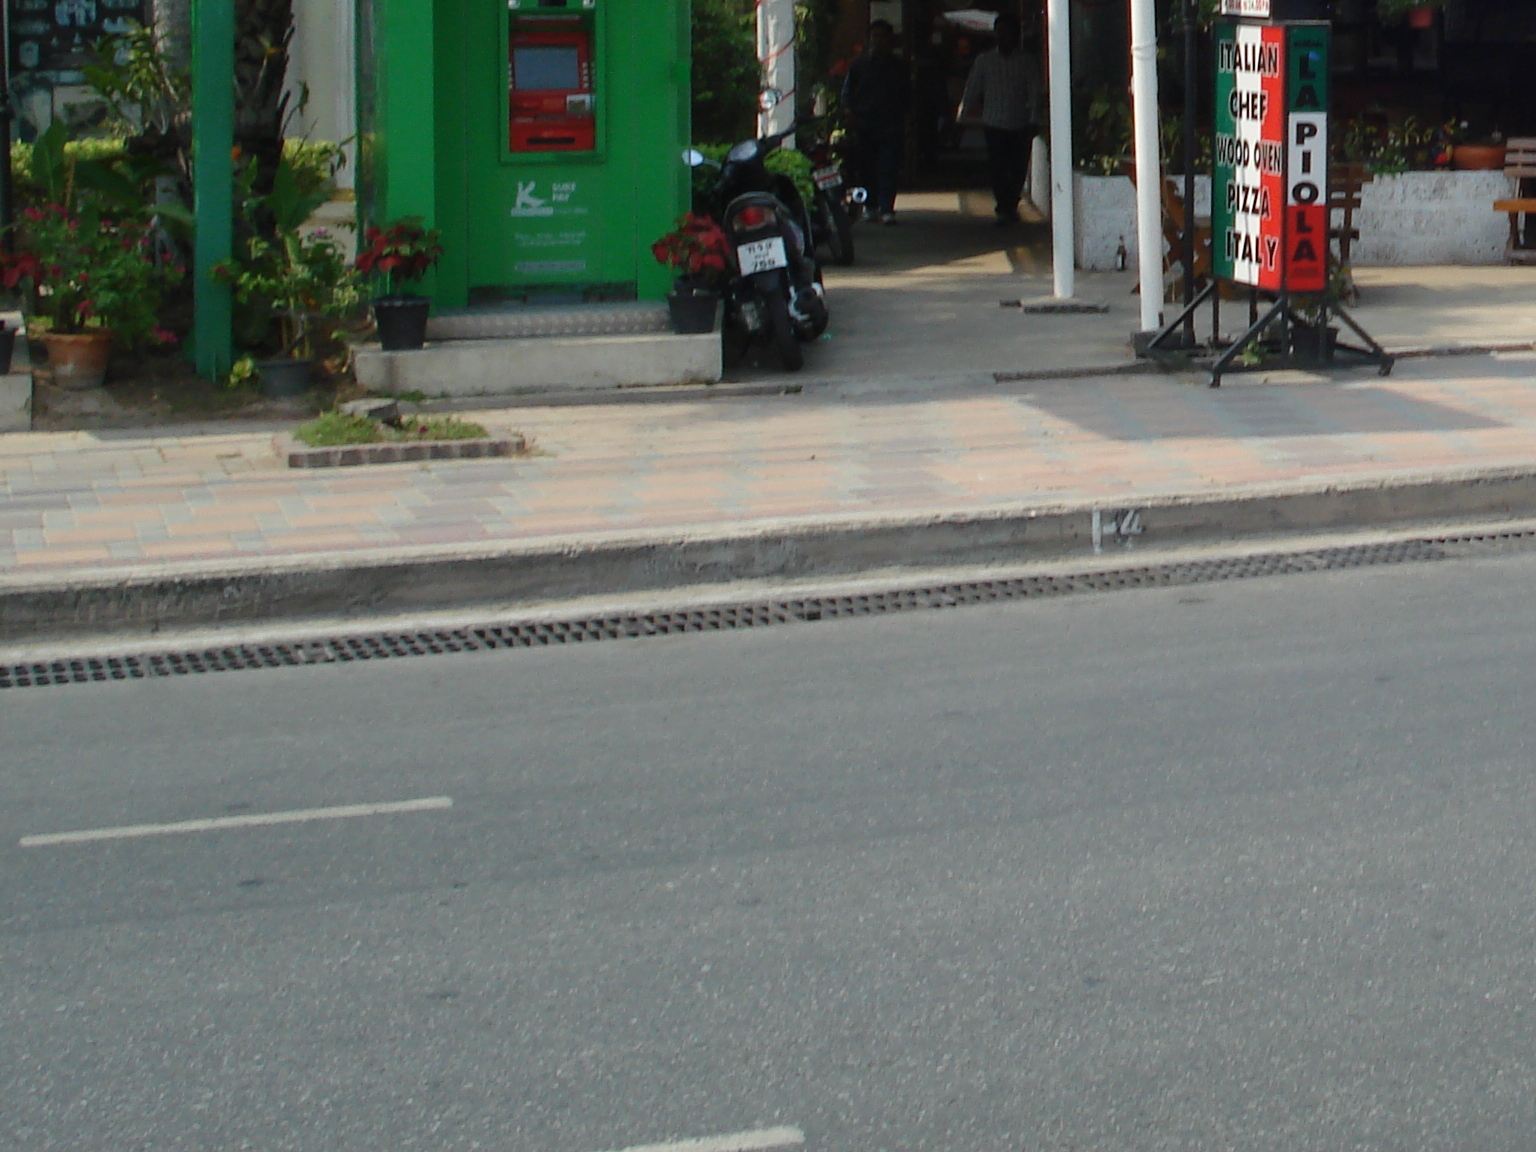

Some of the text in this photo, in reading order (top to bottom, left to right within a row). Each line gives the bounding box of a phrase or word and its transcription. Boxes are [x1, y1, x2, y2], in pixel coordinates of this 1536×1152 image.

[1219, 41, 1279, 77] ITALIAN
[1295, 54, 1320, 107] LA
[1229, 89, 1268, 123] CHEF
[1216, 135, 1282, 175] WOOD OVEN
[1226, 182, 1270, 219] PIZZA
[1292, 122, 1319, 262] PIOLA
[1225, 228, 1278, 270] ITALY
